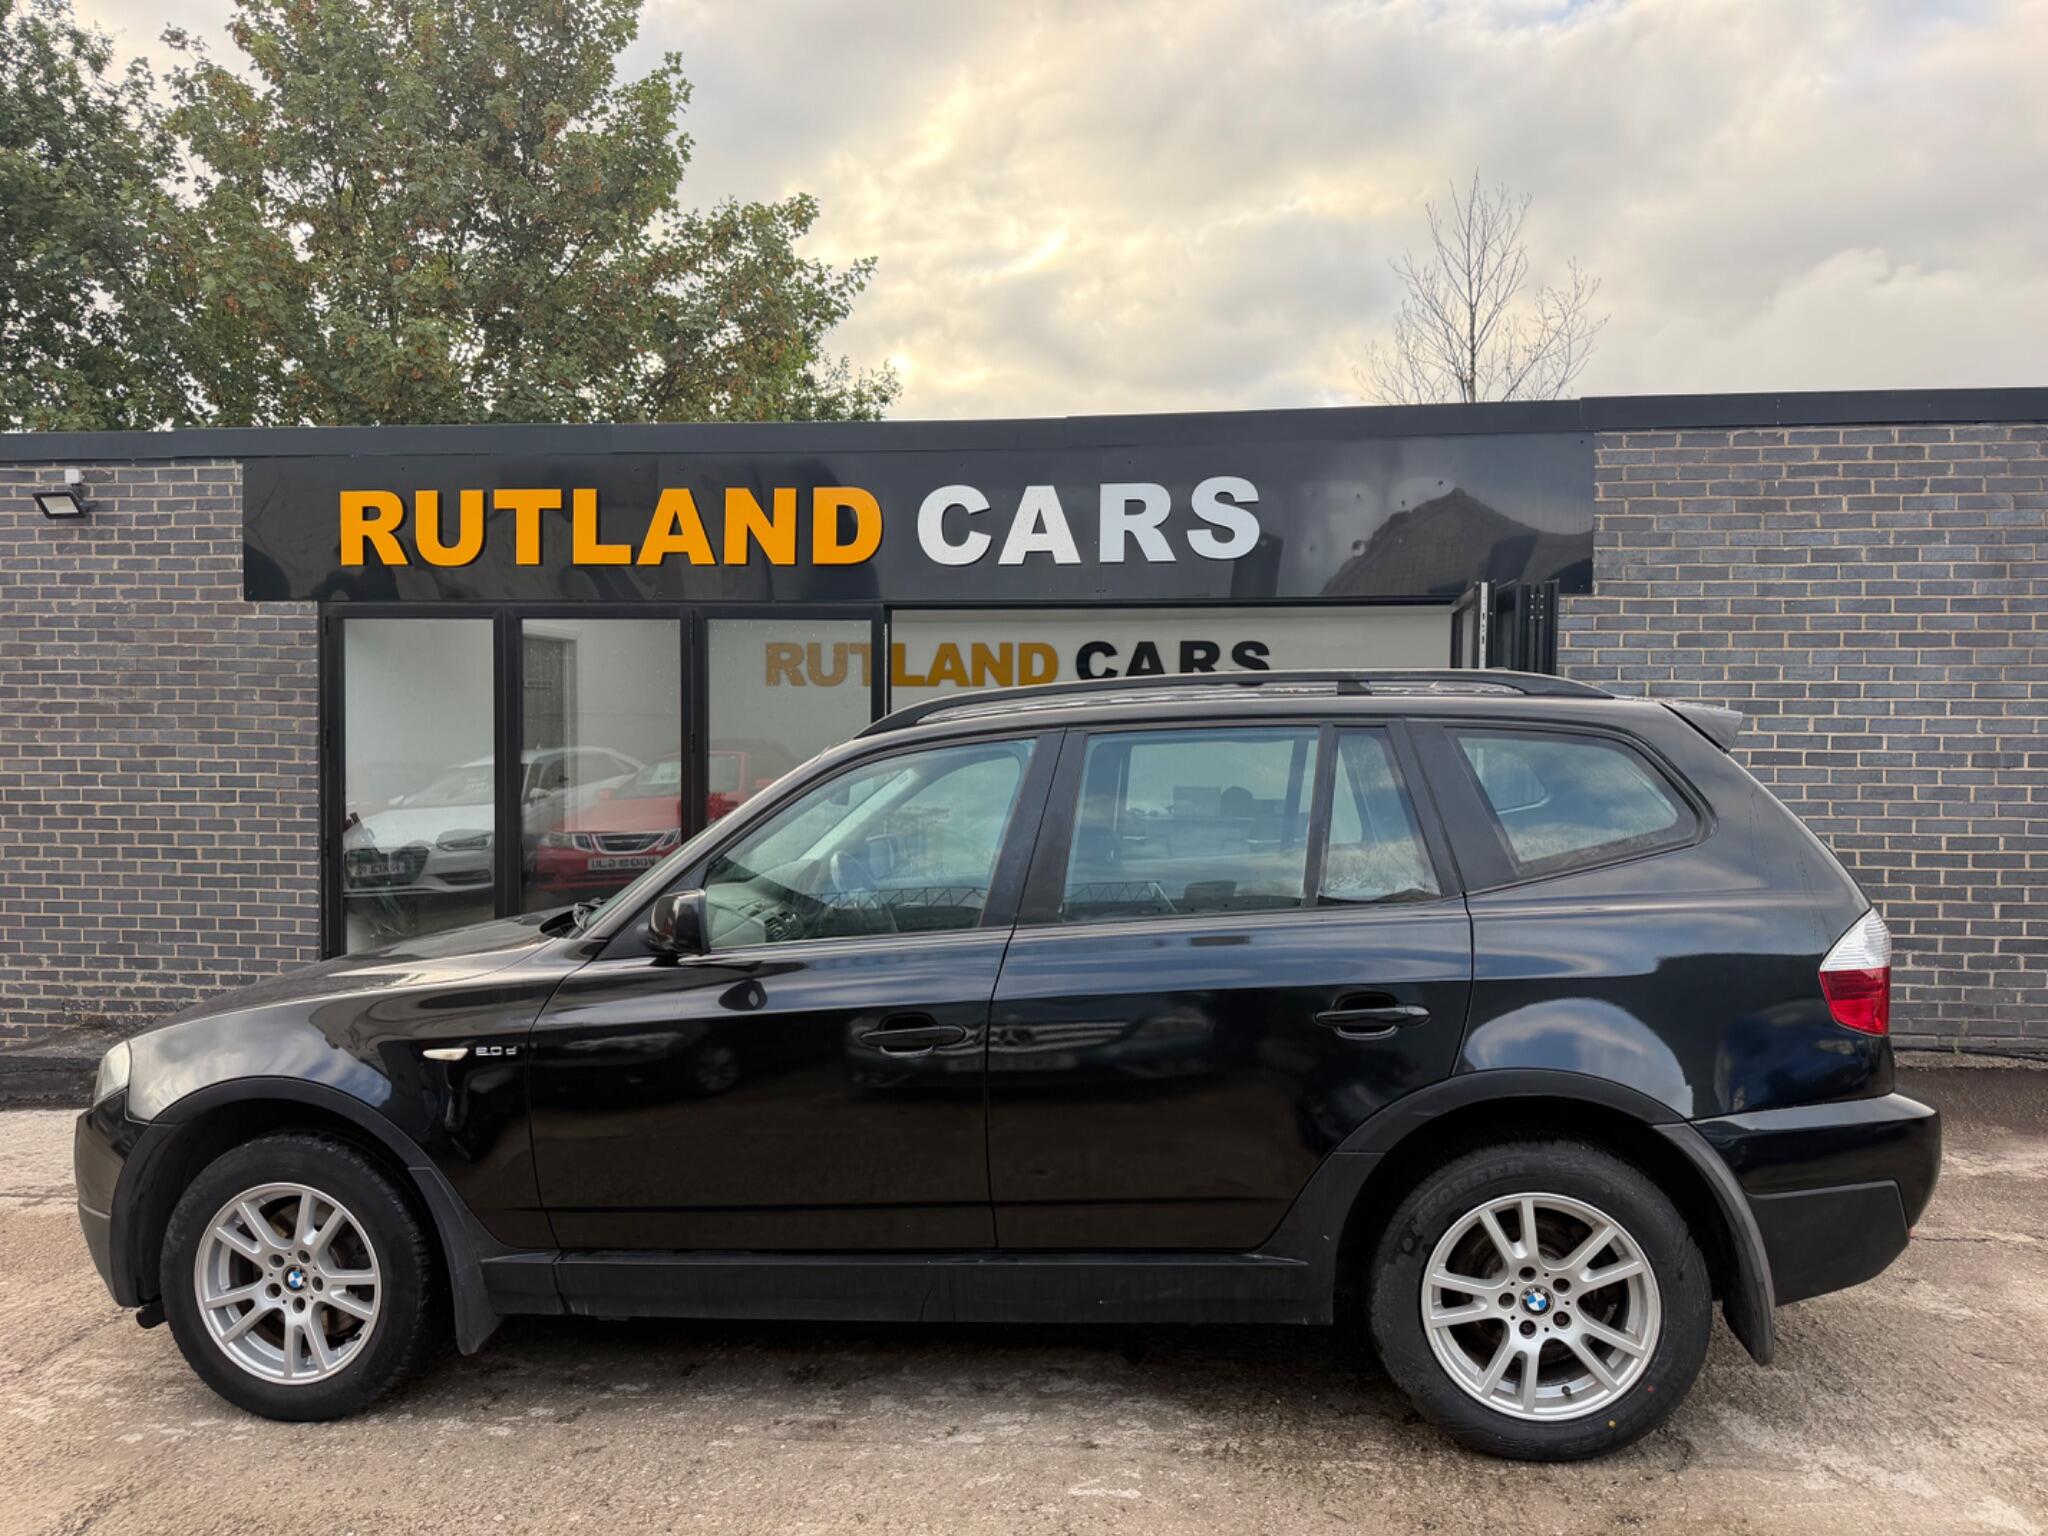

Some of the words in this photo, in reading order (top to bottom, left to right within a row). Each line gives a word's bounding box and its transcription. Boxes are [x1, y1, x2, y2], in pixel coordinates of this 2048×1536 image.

[339, 486, 884, 567] RUTLAND
[917, 475, 1261, 566] CARS
[764, 641, 1060, 688] RUTLAND
[1075, 640, 1271, 681] CARS
